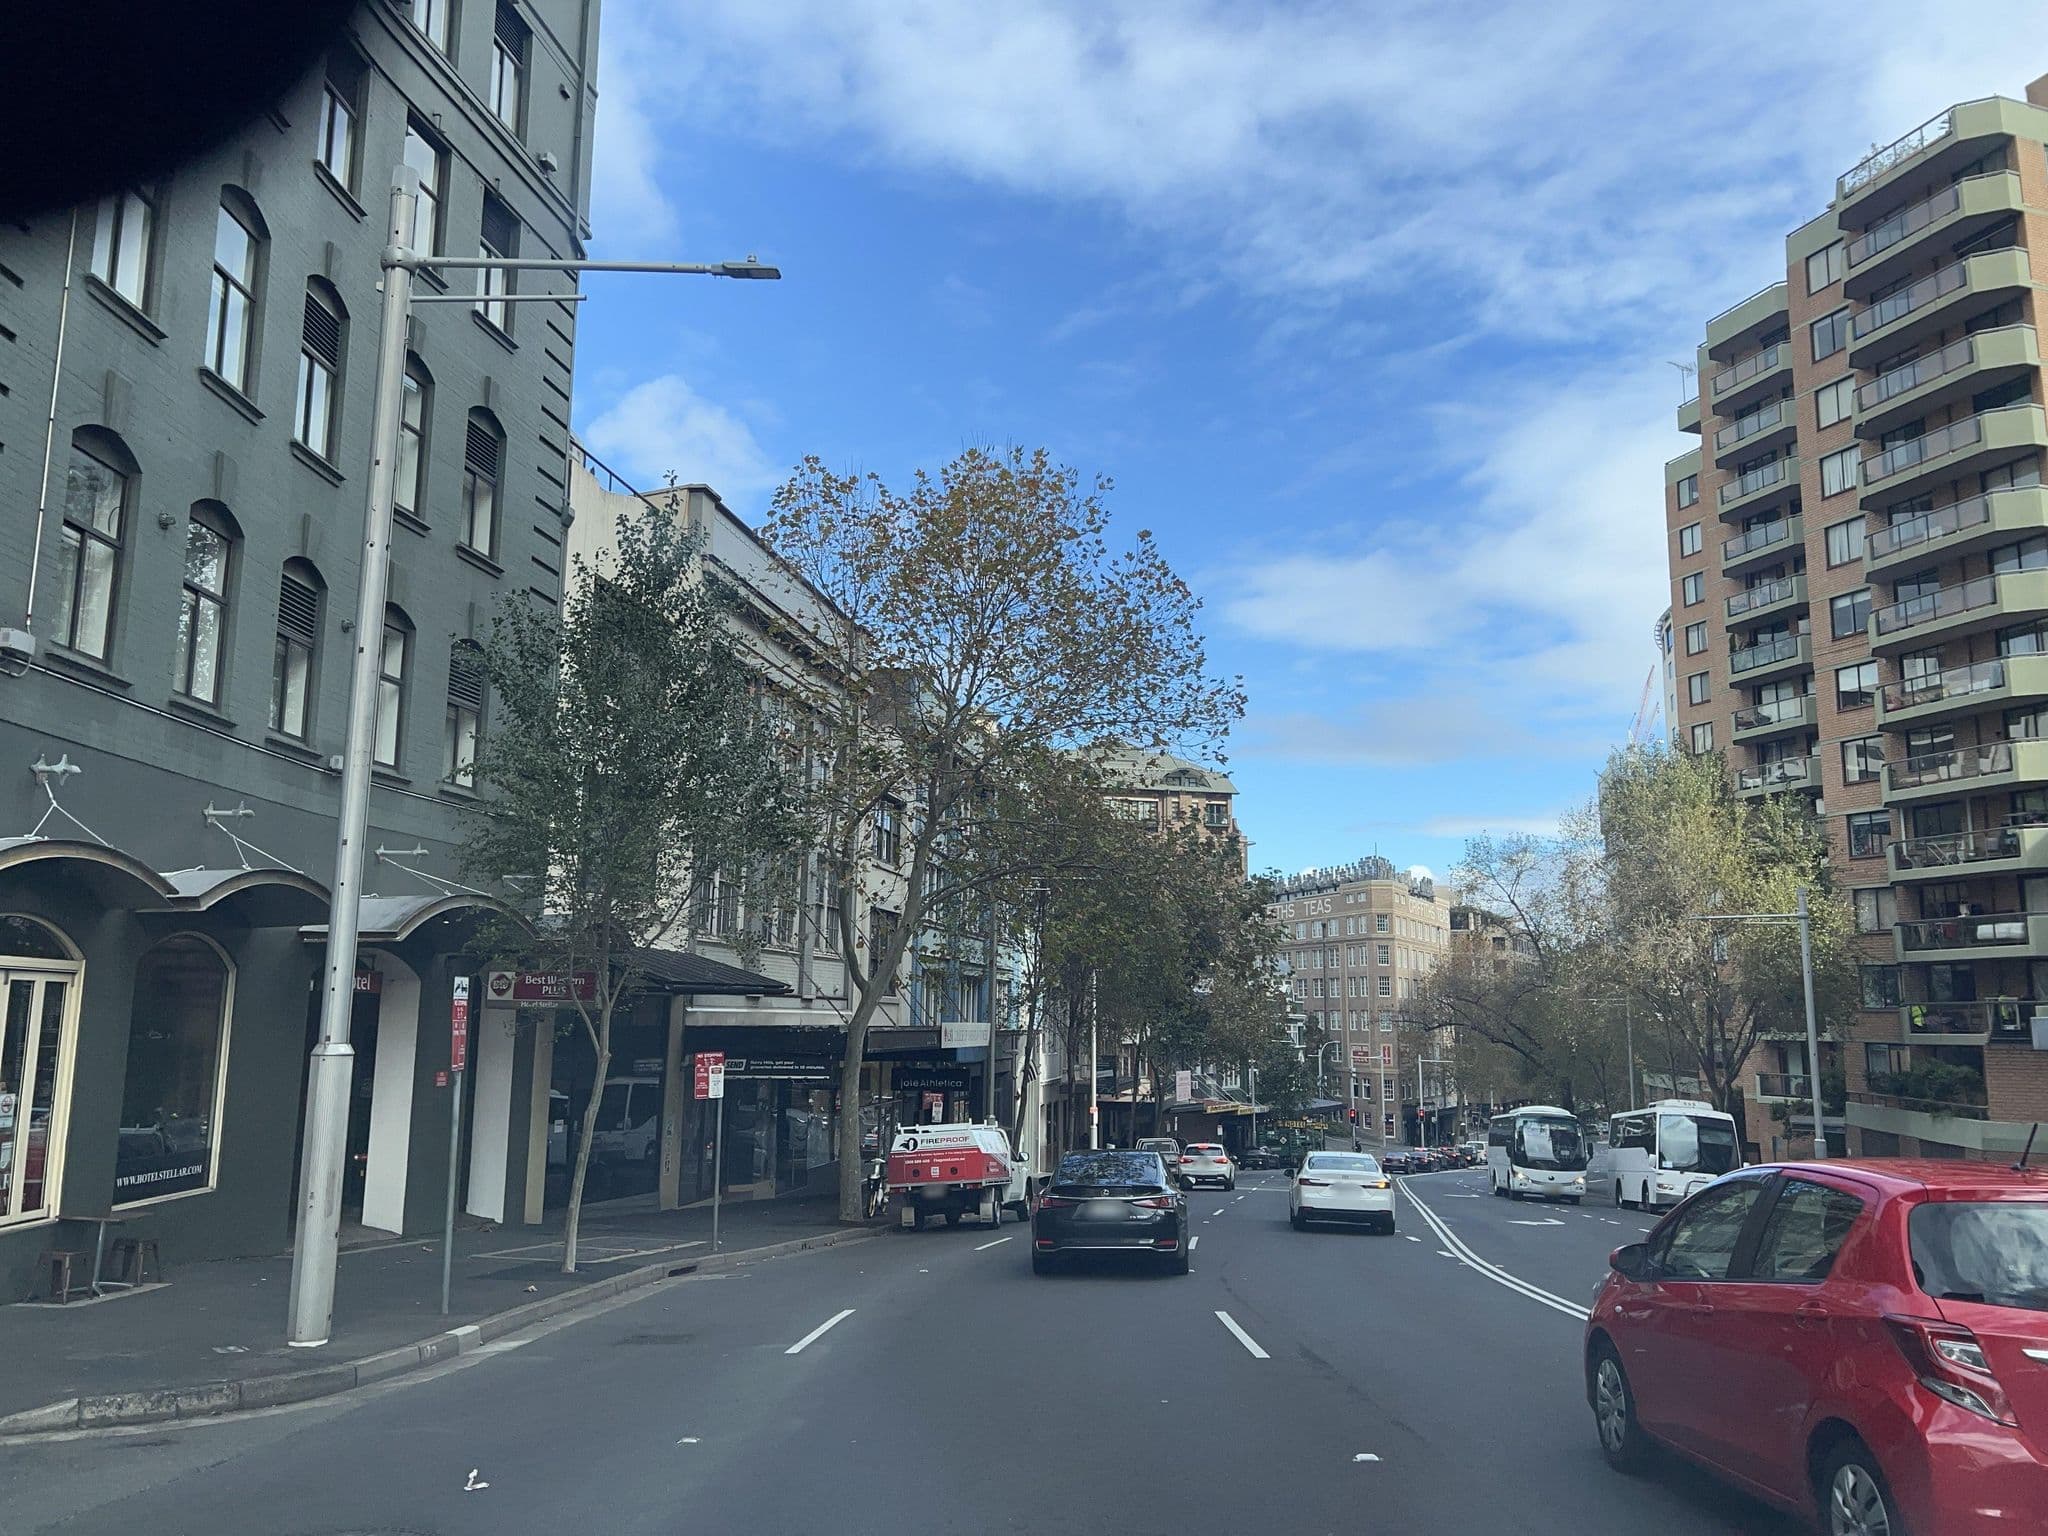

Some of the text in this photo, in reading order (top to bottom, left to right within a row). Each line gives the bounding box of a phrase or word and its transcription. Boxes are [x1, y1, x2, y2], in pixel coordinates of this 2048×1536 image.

[1303, 898, 1332, 916] TEAS
[525, 975, 545, 985] Best
[920, 1135, 970, 1145] FIREPROOF
[116, 1164, 203, 1188] WWW.HOTELSTELLAR.COM
